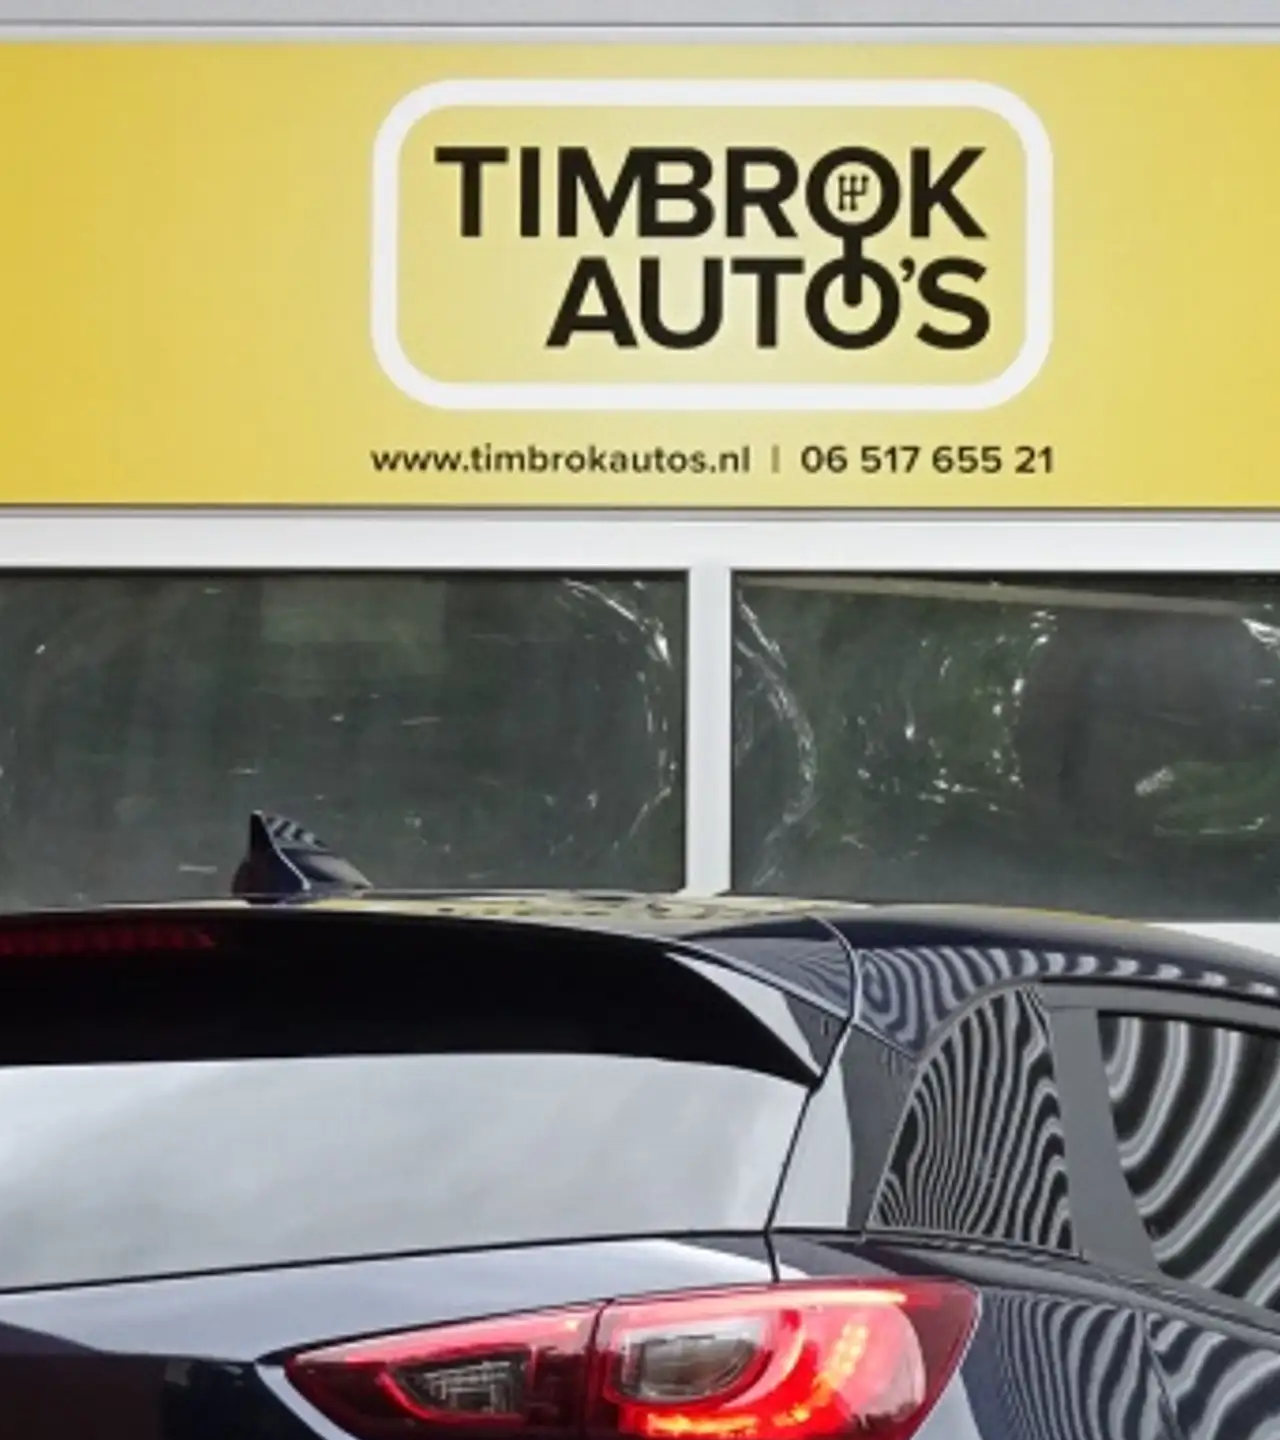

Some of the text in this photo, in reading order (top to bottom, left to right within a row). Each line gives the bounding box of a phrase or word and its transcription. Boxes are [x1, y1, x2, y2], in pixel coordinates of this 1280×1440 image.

[434, 146, 988, 239] TIMBROK
[545, 256, 991, 350] AUTO'S
[371, 443, 1053, 474] www.timbrokautos.nl 06 517 655 21
